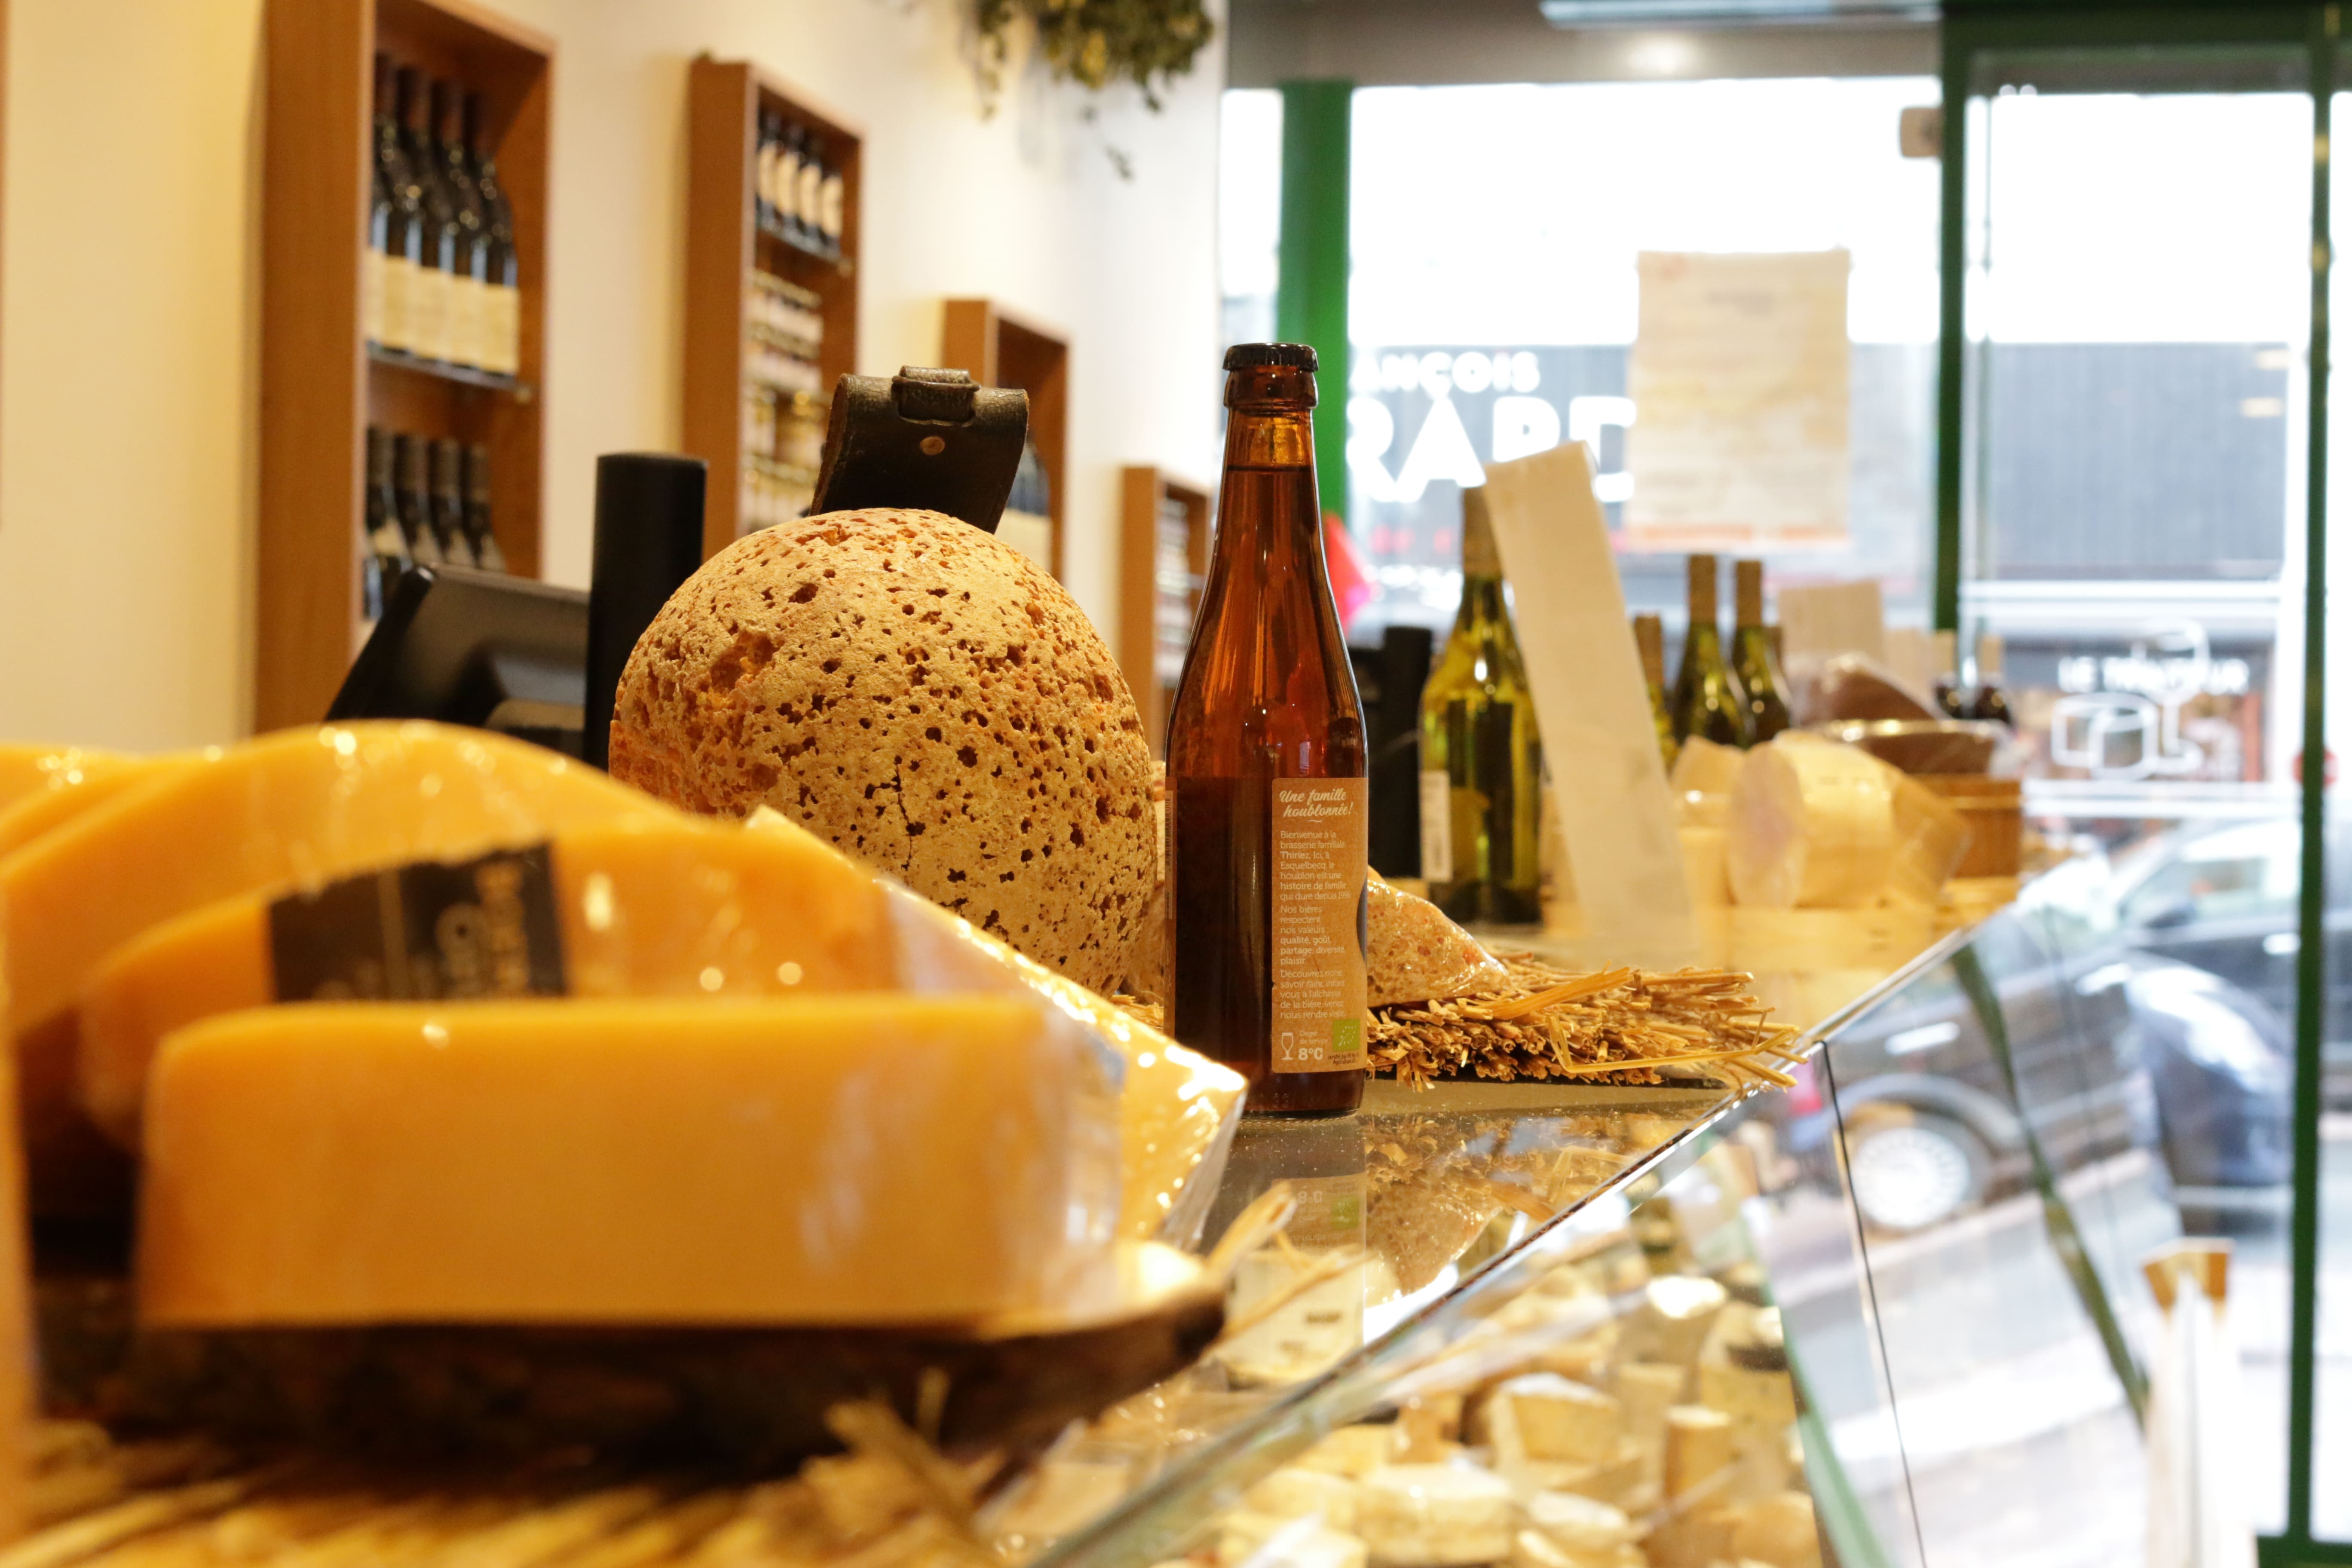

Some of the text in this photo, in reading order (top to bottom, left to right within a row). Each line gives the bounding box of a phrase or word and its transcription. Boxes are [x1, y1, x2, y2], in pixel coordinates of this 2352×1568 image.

[1279, 787, 1346, 805] Une famille
[1283, 801, 1354, 818] houblonnée!
[1280, 830, 1336, 839] Bienvenue à la
[1280, 841, 1316, 849] brasserie
[1325, 851, 1329, 859] à
[1280, 871, 1314, 879] houblon
[1280, 882, 1311, 890] histoire
[1325, 881, 1346, 889] famille
[1280, 893, 1293, 901] qui
[1314, 891, 1337, 901] depuis
[1299, 904, 1322, 913] bières
[1280, 916, 1320, 925] respectent
[1298, 925, 1325, 934] valeurs
[1280, 936, 1311, 945] qualité,
[1280, 946, 1314, 956] partage,
[1280, 956, 1307, 966] plaisir.
[1280, 970, 1323, 978] Découvrez
[1280, 980, 1305, 988] savoir
[1302, 989, 1307, 998] à
[1280, 1000, 1291, 1008] de
[1293, 1000, 1300, 1008] la
[1303, 1010, 1328, 1018] rendre
[1298, 1047, 1323, 1061] 8°C
